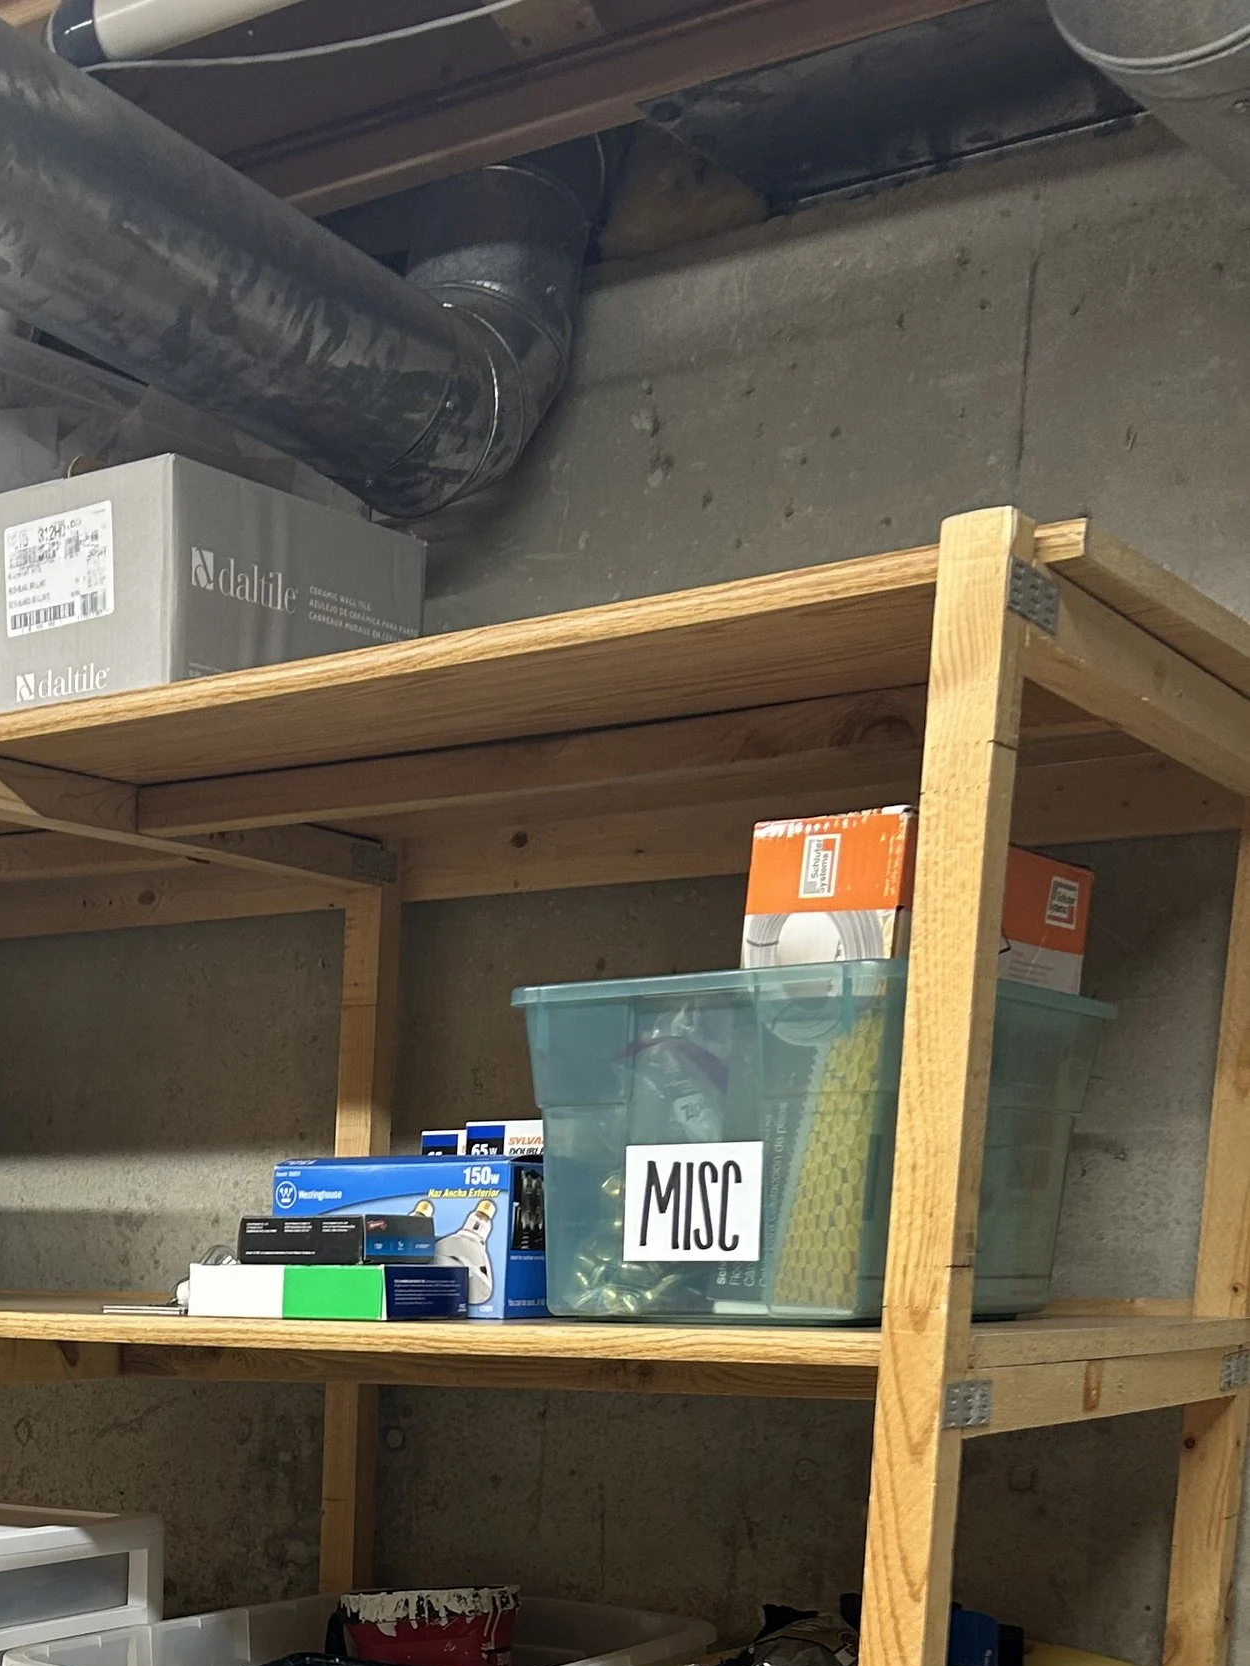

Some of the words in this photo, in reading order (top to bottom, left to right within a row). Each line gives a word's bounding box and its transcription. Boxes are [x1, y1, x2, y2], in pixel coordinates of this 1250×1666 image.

[218, 557, 296, 614] daltile
[38, 662, 109, 698] daltile
[508, 1137, 543, 1146] SYLVA
[509, 1147, 543, 1156] DOUBL
[639, 1160, 742, 1251] MISC
